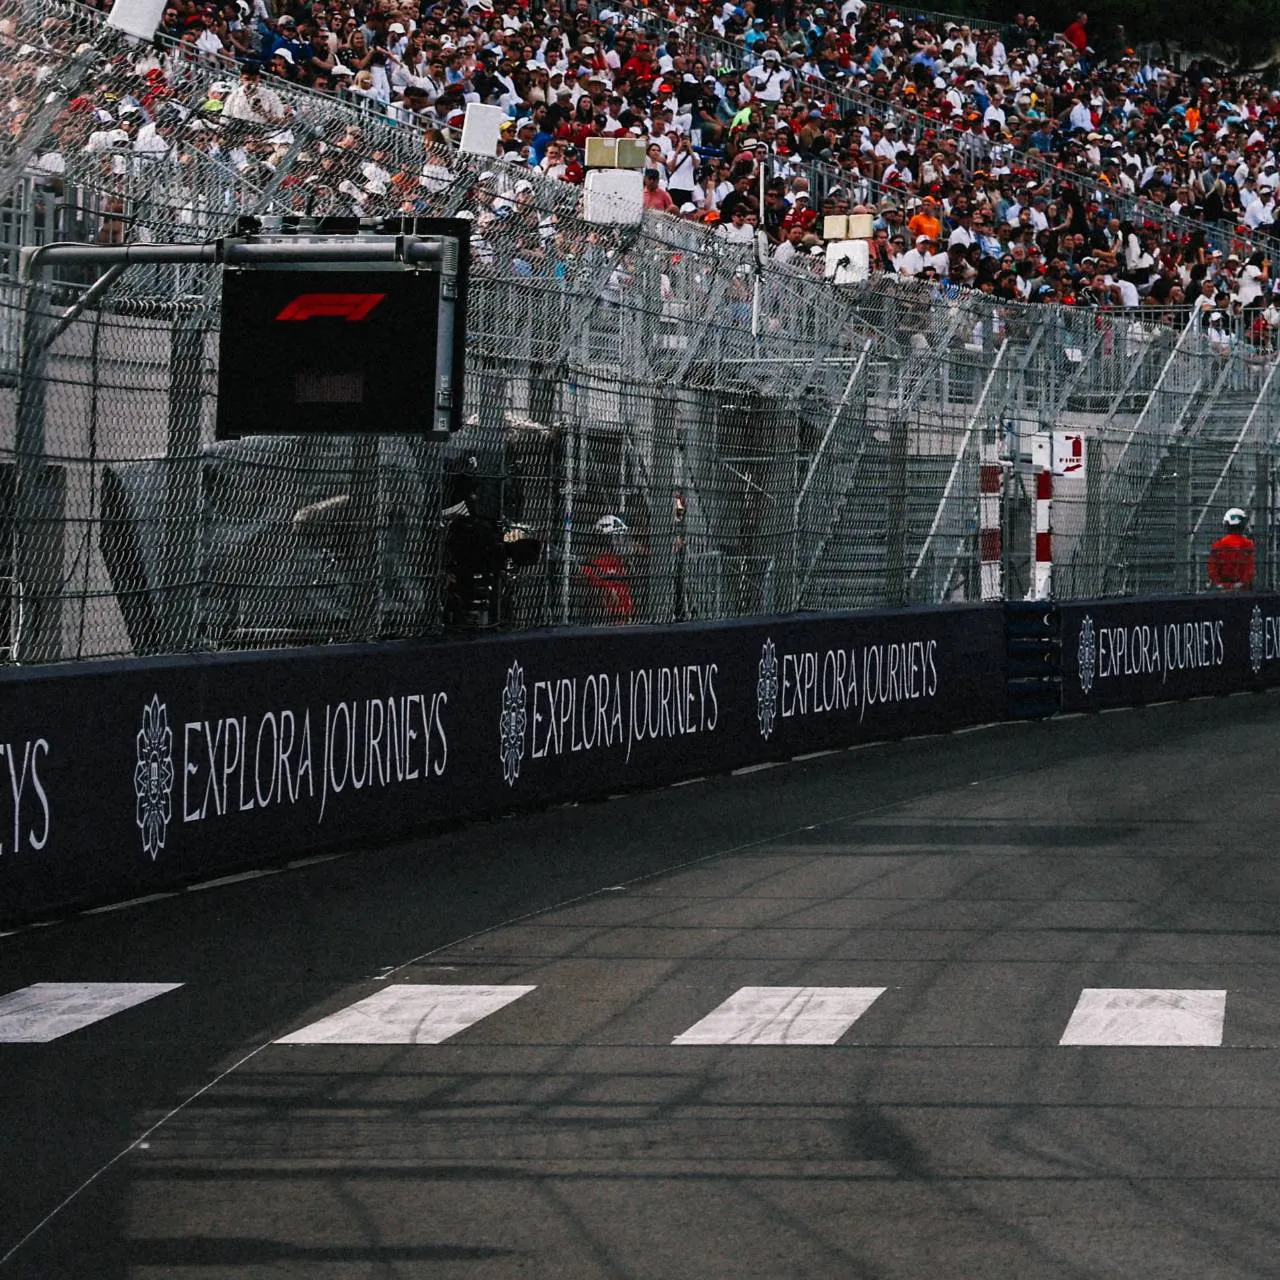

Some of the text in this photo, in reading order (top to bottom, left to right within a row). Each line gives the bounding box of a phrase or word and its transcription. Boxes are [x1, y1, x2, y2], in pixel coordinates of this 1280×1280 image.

[782, 640, 937, 724] EXPLORA JOURNEYS
[1099, 620, 1224, 684] EXPLORA JOURNEYS
[184, 692, 449, 824] EXPLORA JOURNEYS
[532, 663, 719, 765] EXPLORA JOURNEYS
